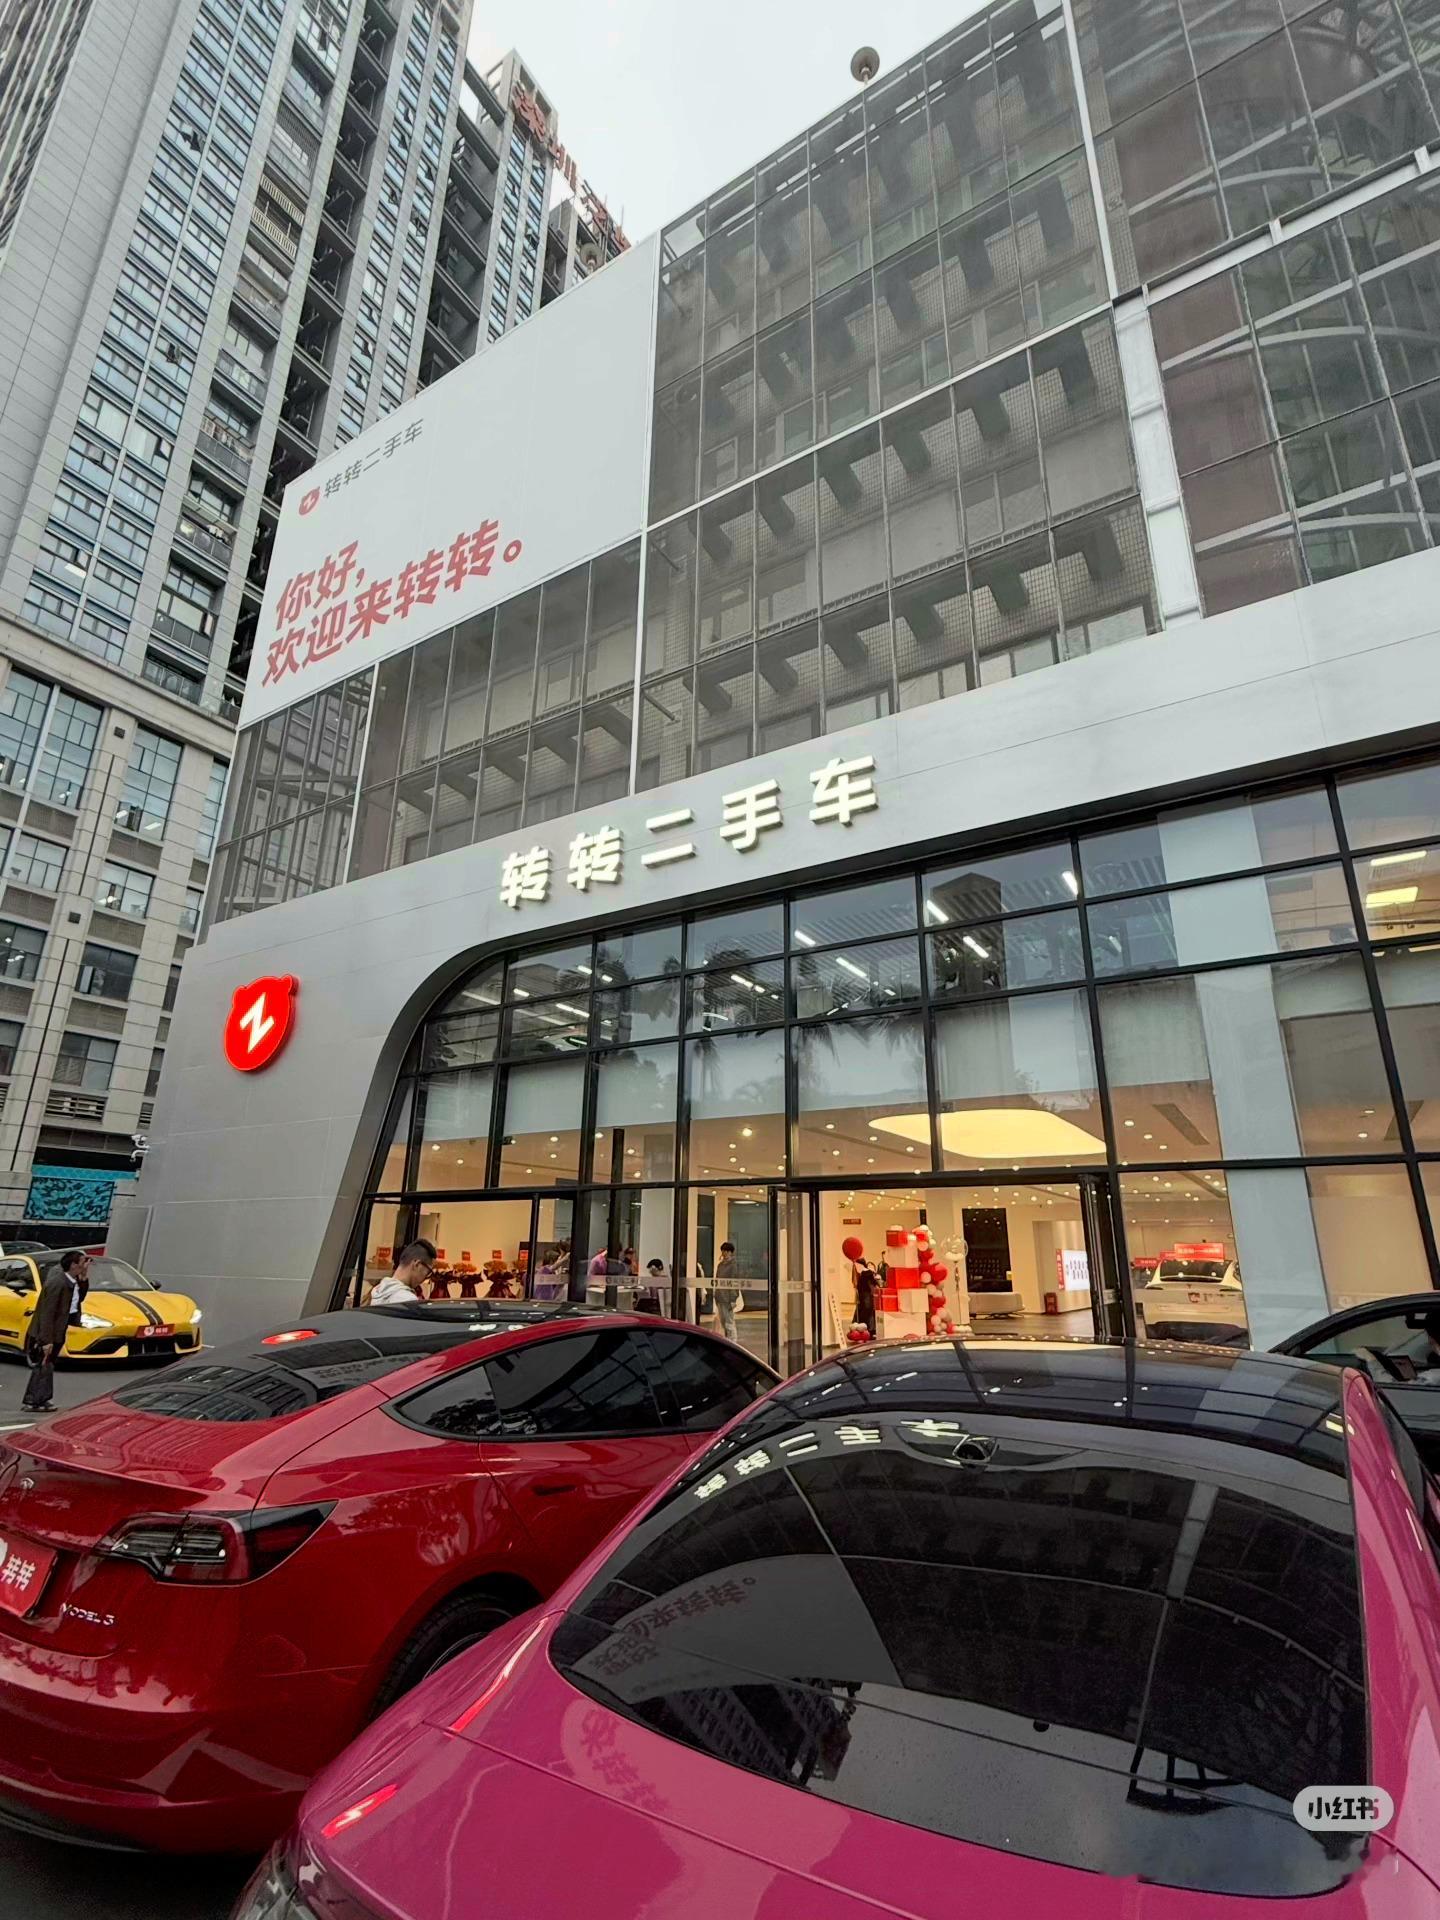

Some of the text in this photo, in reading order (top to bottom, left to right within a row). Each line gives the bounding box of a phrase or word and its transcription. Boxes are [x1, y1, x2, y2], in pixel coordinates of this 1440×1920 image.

[324, 418, 424, 499] 转转二手车
[261, 518, 523, 688] 欢迎来转转。
[276, 539, 366, 631] 你好，
[500, 755, 879, 910] 转转二手车
[1, 1553, 36, 1592] 转转
[103, 1614, 115, 1626] 3
